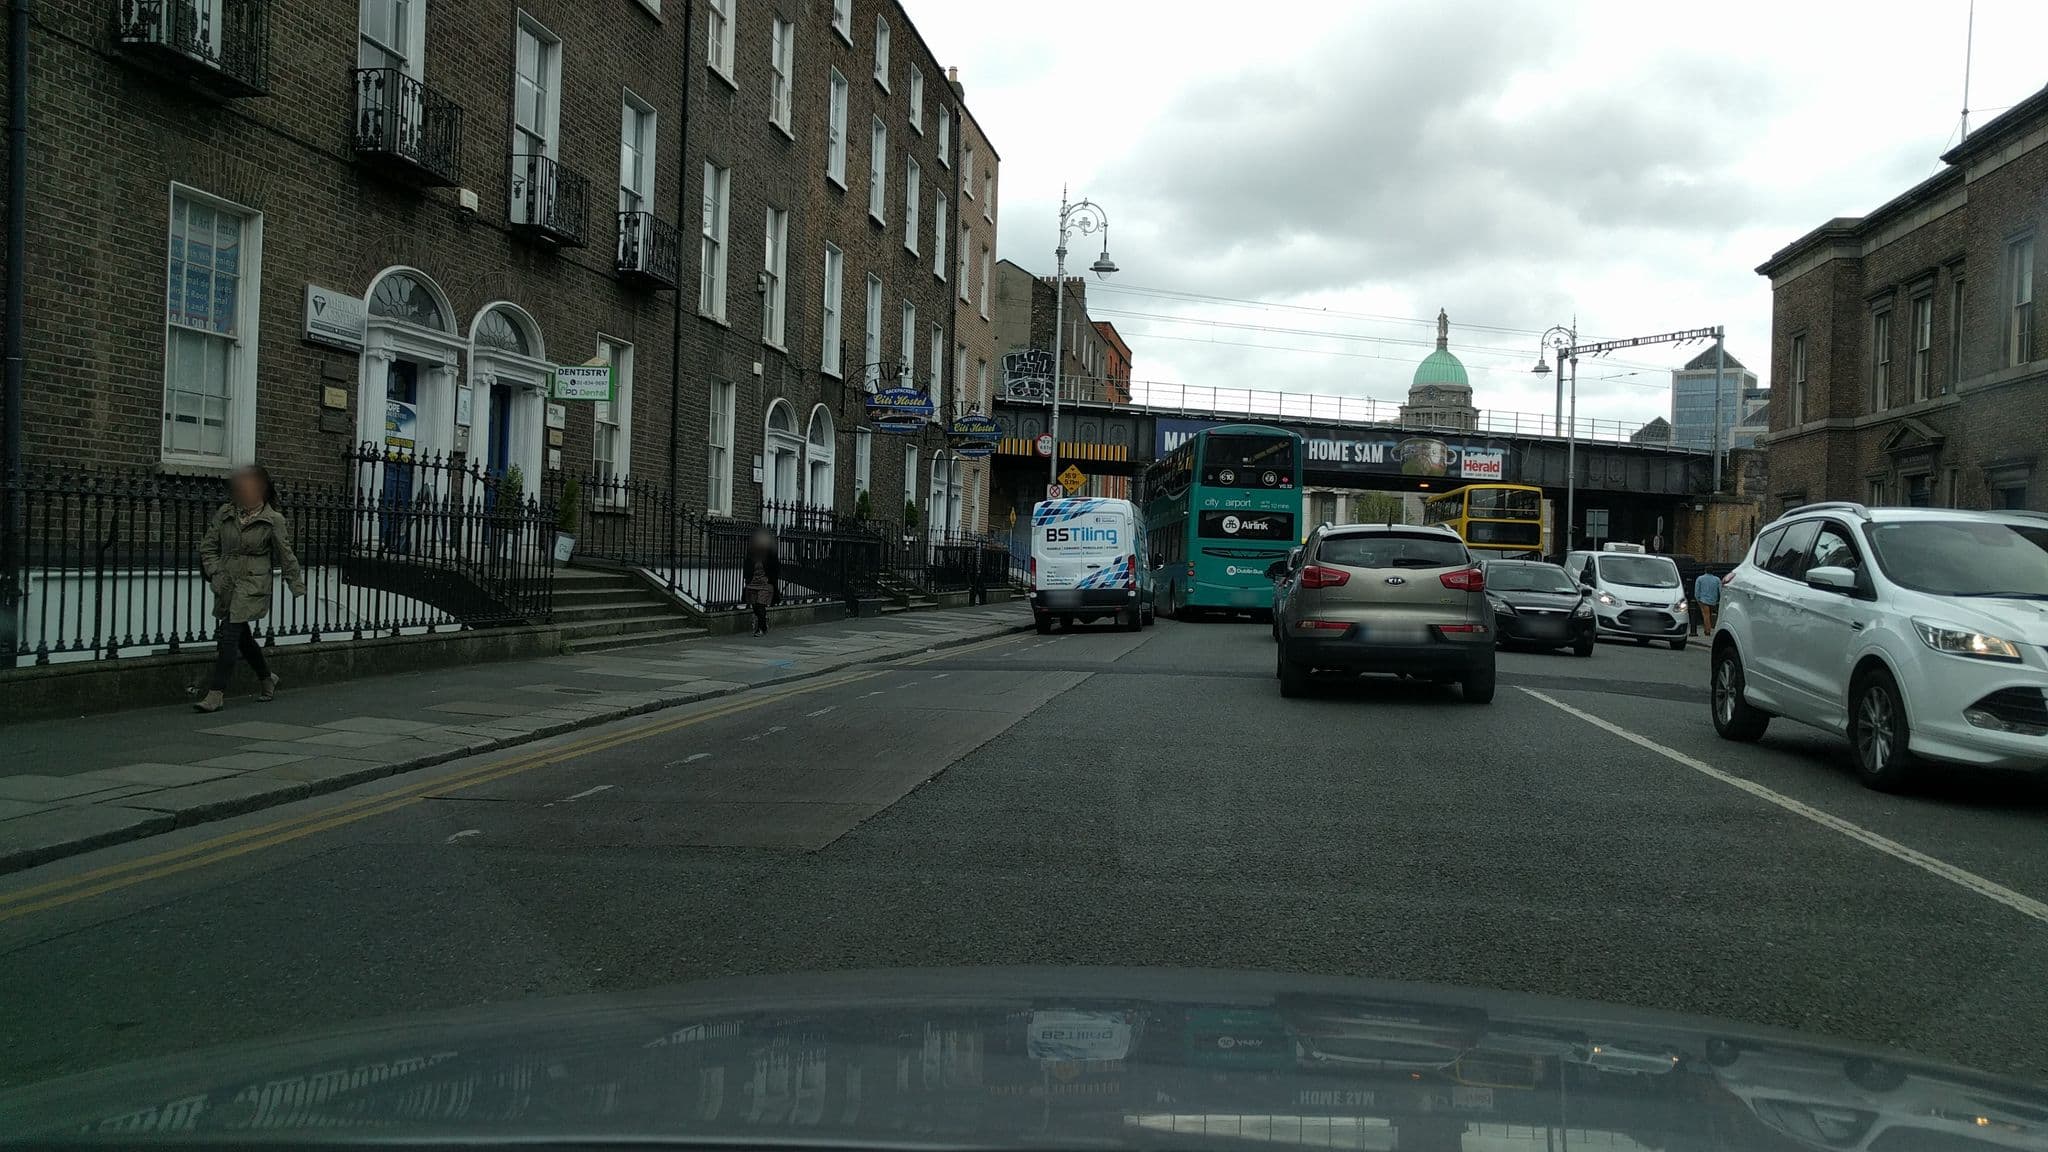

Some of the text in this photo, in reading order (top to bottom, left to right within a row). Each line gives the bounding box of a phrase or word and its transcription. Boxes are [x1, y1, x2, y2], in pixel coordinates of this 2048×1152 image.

[558, 368, 608, 377] DENTISTRY
[566, 388, 607, 397] PD Dental
[873, 393, 927, 406] Citi Hostel
[954, 422, 996, 432] Citi Hostel
[1308, 440, 1384, 463] HOME SAM
[1464, 459, 1500, 473] Herald
[1204, 498, 1252, 509] city airport
[1241, 520, 1269, 531] Airlink
